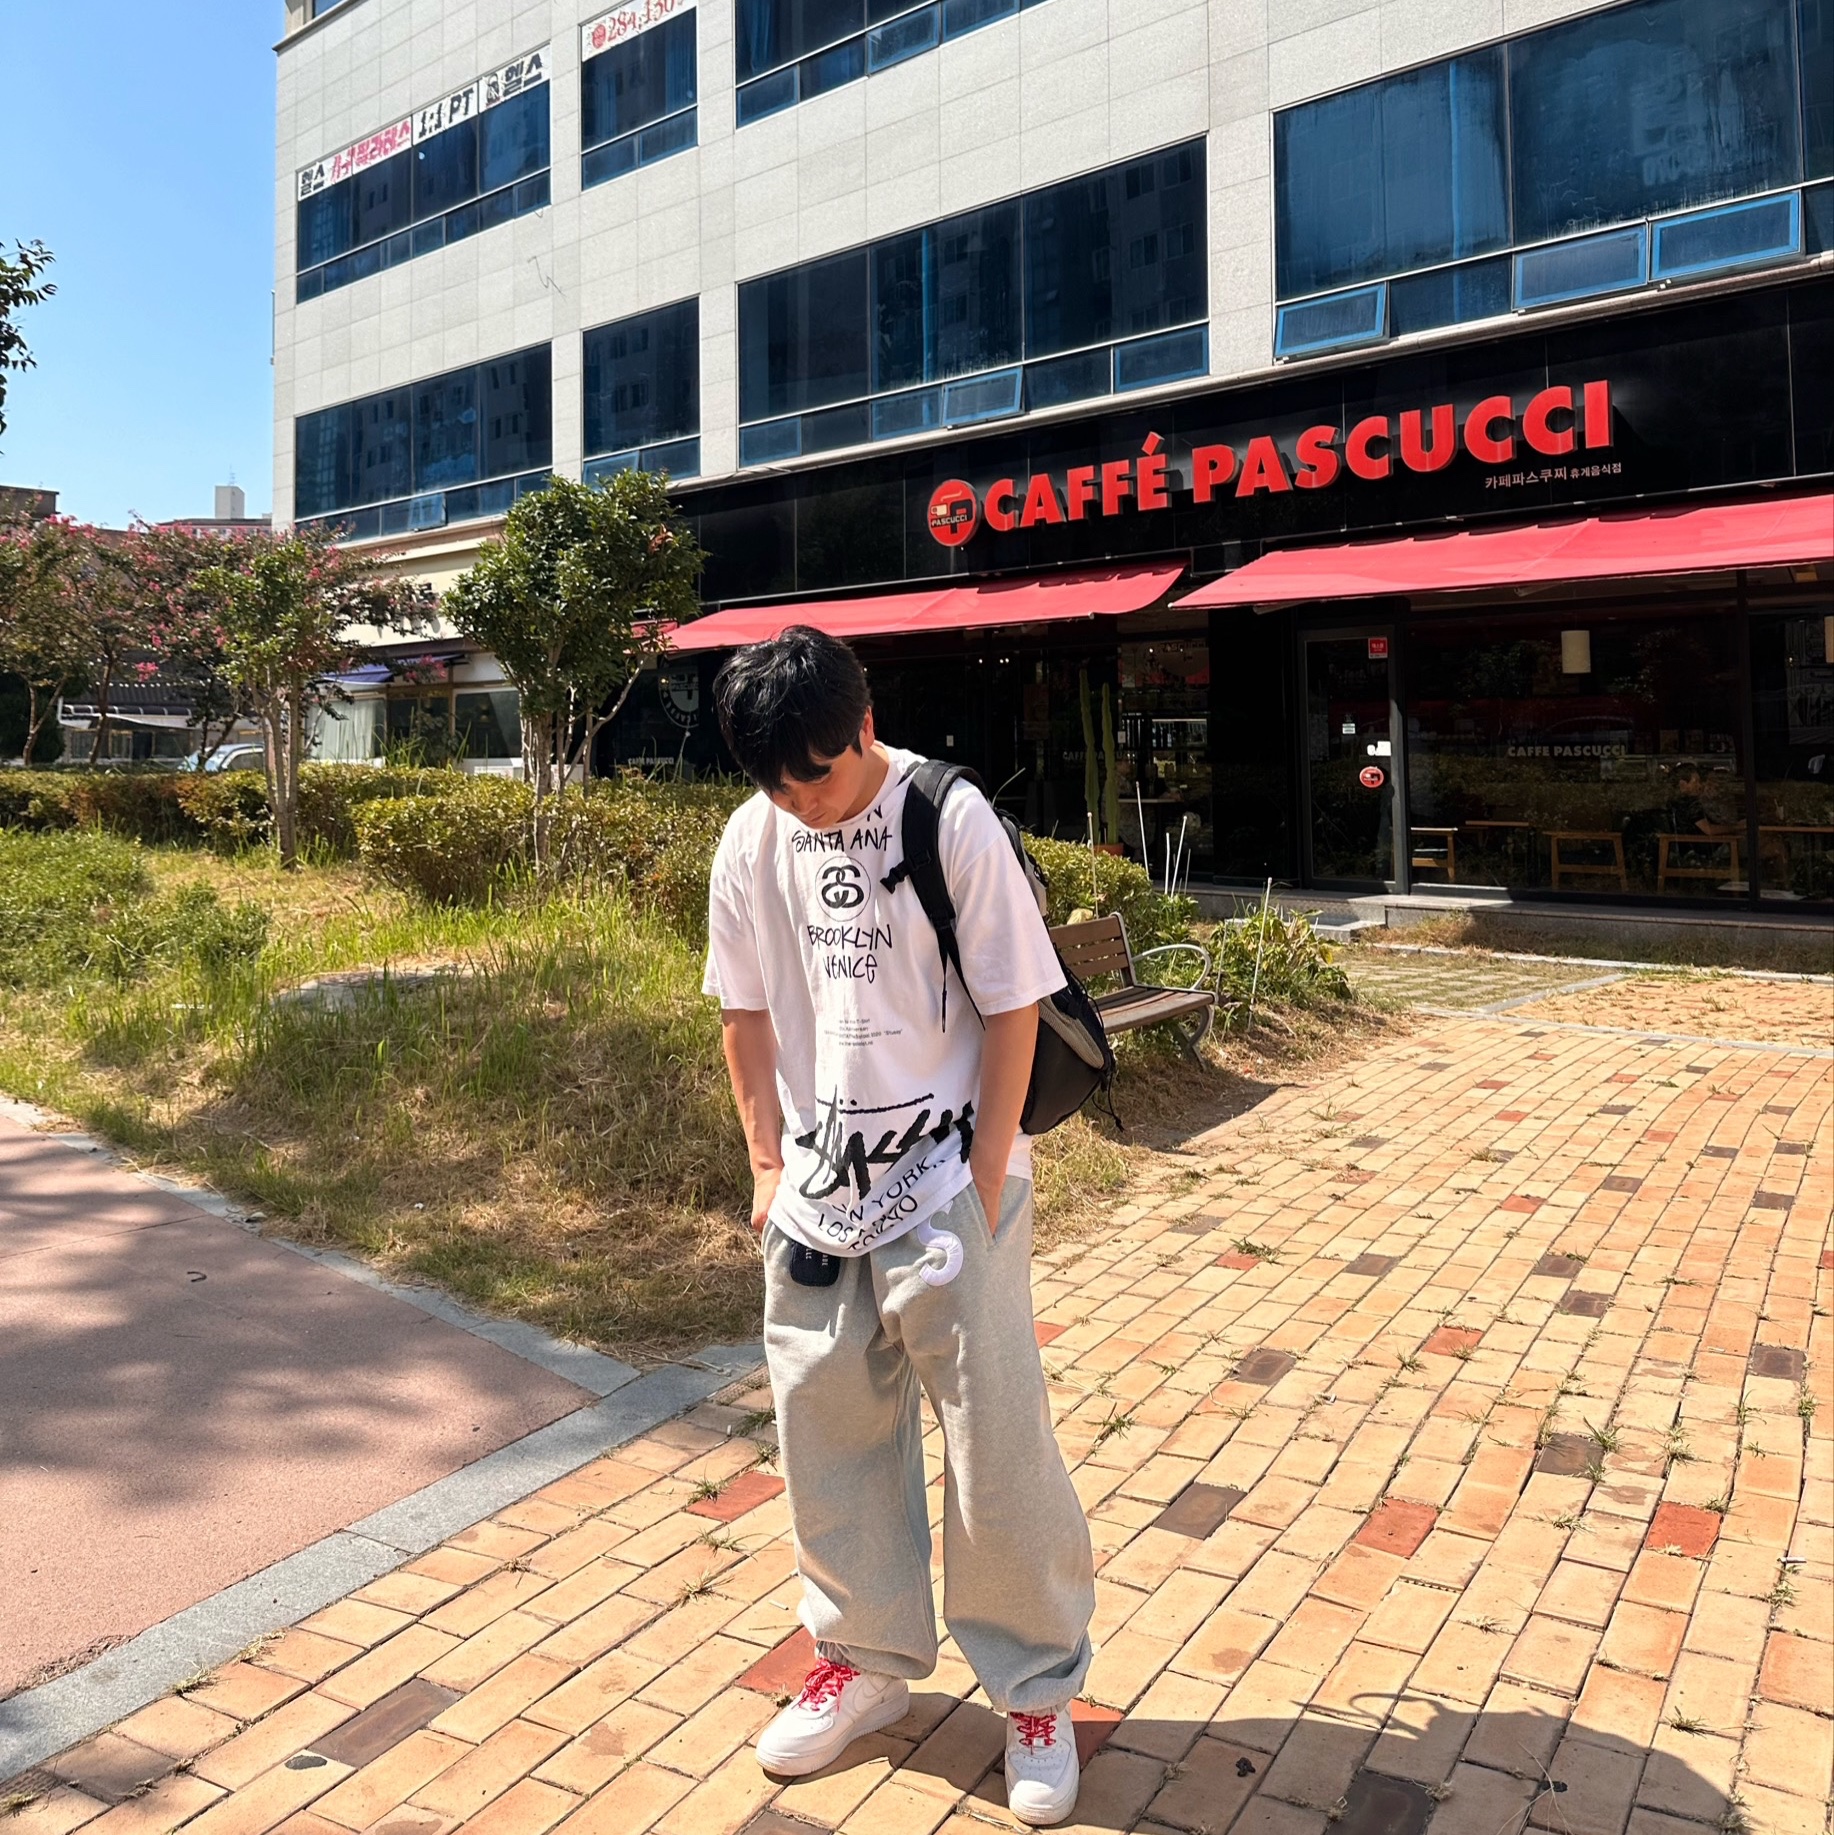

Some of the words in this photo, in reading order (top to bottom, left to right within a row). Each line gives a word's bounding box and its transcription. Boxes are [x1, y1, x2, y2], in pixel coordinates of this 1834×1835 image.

[300, 163, 325, 198] 헬스
[418, 102, 443, 139] 1:1
[448, 86, 475, 124] PT
[502, 52, 543, 98] 헬스
[984, 431, 1170, 532] CAFFÉ
[1191, 379, 1611, 504] PASCUCCI
[1484, 466, 1567, 489] 카페파스쿠찌
[1570, 462, 1622, 479] 휴게음식점
[930, 514, 968, 527] PASCUCCI
[1507, 744, 1551, 758] CAFFE
[1553, 743, 1627, 758] PASCUCCI
[791, 829, 845, 853] SANTA
[850, 826, 893, 852] ANA
[806, 923, 893, 951] BROOKLYN
